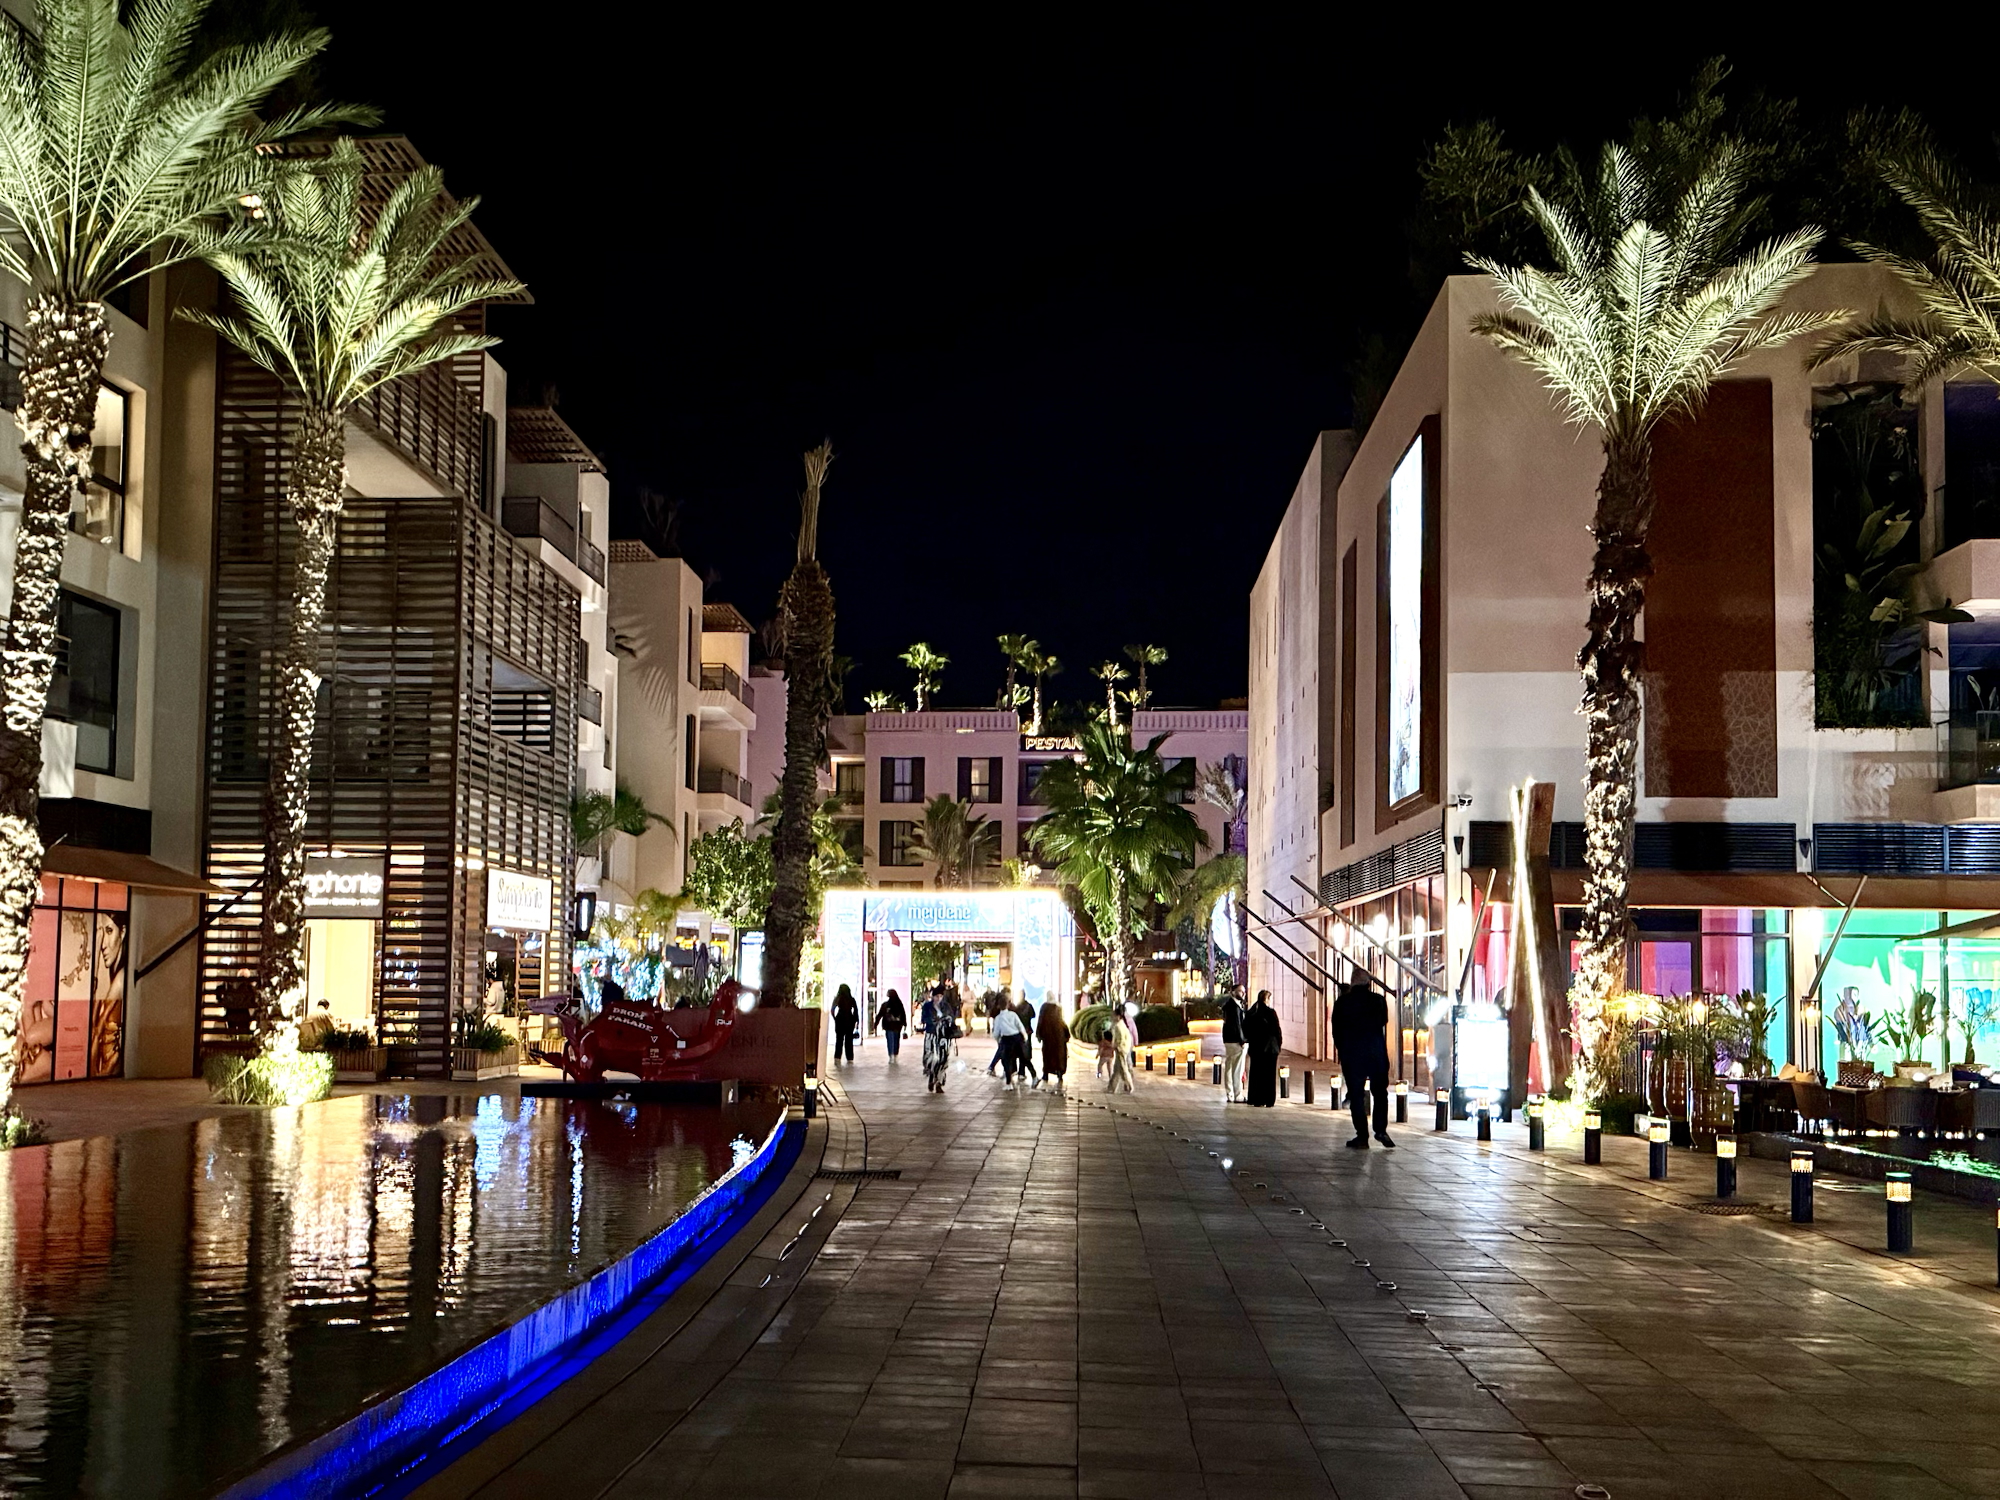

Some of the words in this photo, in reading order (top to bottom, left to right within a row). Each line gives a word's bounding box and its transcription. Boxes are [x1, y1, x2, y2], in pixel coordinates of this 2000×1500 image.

[908, 901, 971, 927] meydene
[612, 1007, 645, 1020] DROM
[607, 1014, 654, 1032] PARADE
